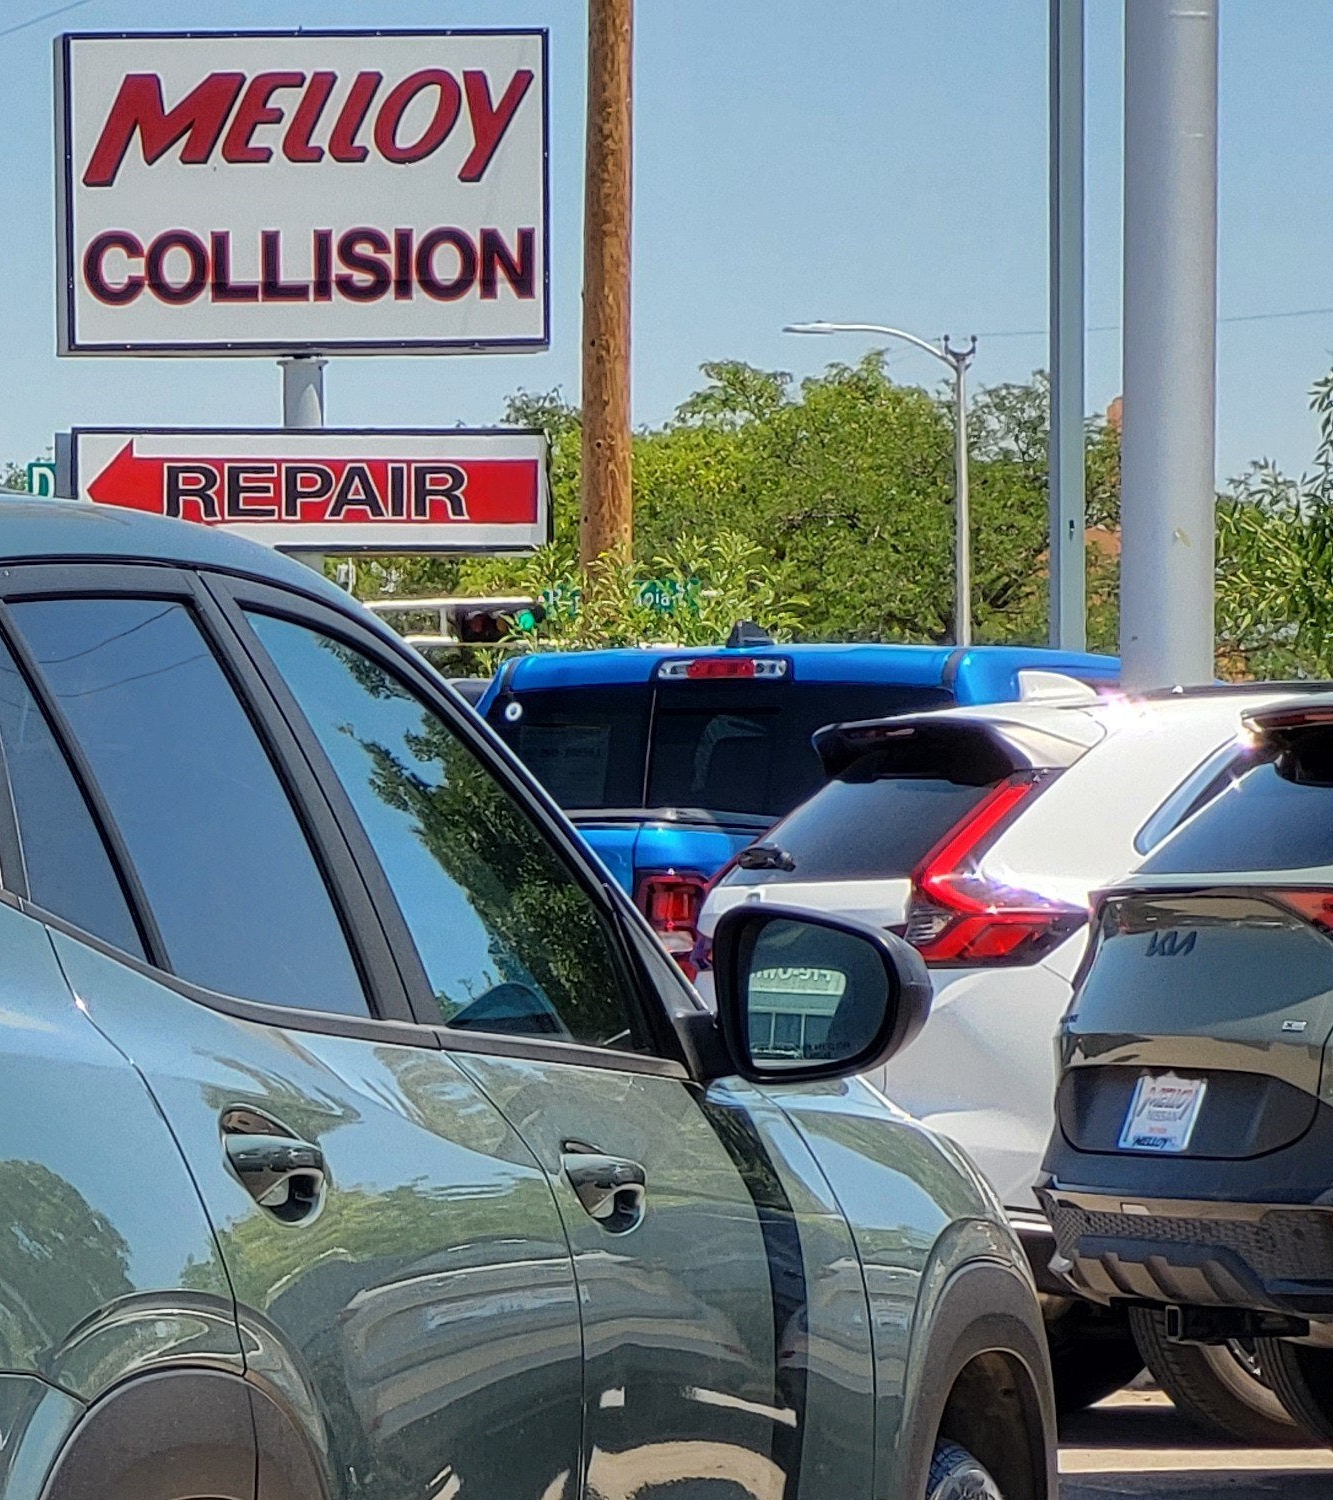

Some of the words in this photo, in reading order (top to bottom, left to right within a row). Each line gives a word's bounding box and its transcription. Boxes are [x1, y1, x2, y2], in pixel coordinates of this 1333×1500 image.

[83, 68, 533, 187] MELLOY
[83, 227, 535, 305] COLLISION
[162, 462, 470, 521] REPAIR
